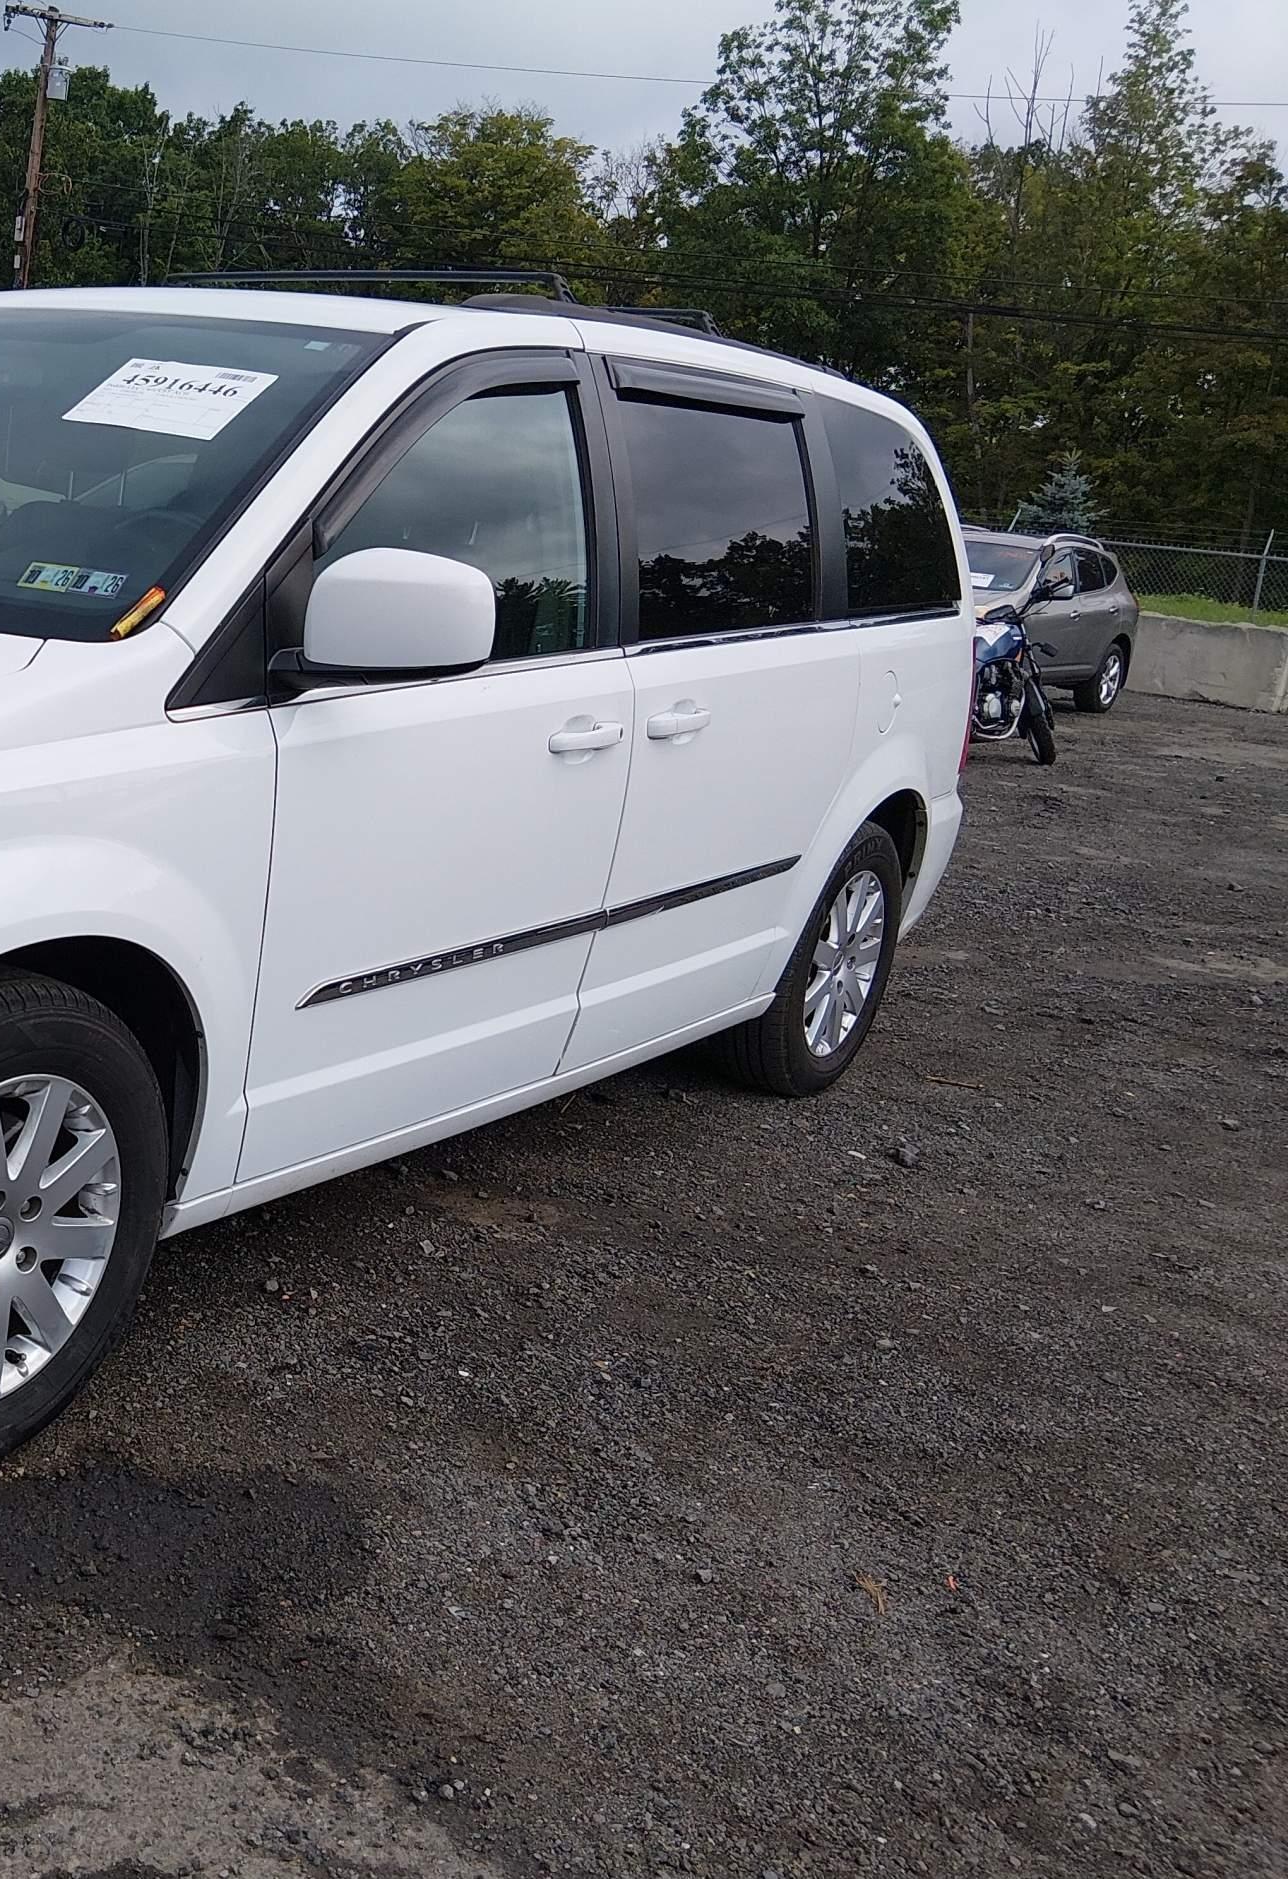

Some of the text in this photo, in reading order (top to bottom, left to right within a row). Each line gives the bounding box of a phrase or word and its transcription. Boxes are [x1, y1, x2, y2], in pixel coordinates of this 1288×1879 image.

[123, 374, 242, 397] 45916446
[56, 569, 74, 587] 26
[104, 577, 123, 593] 26
[338, 942, 504, 994] CHRYSLER
